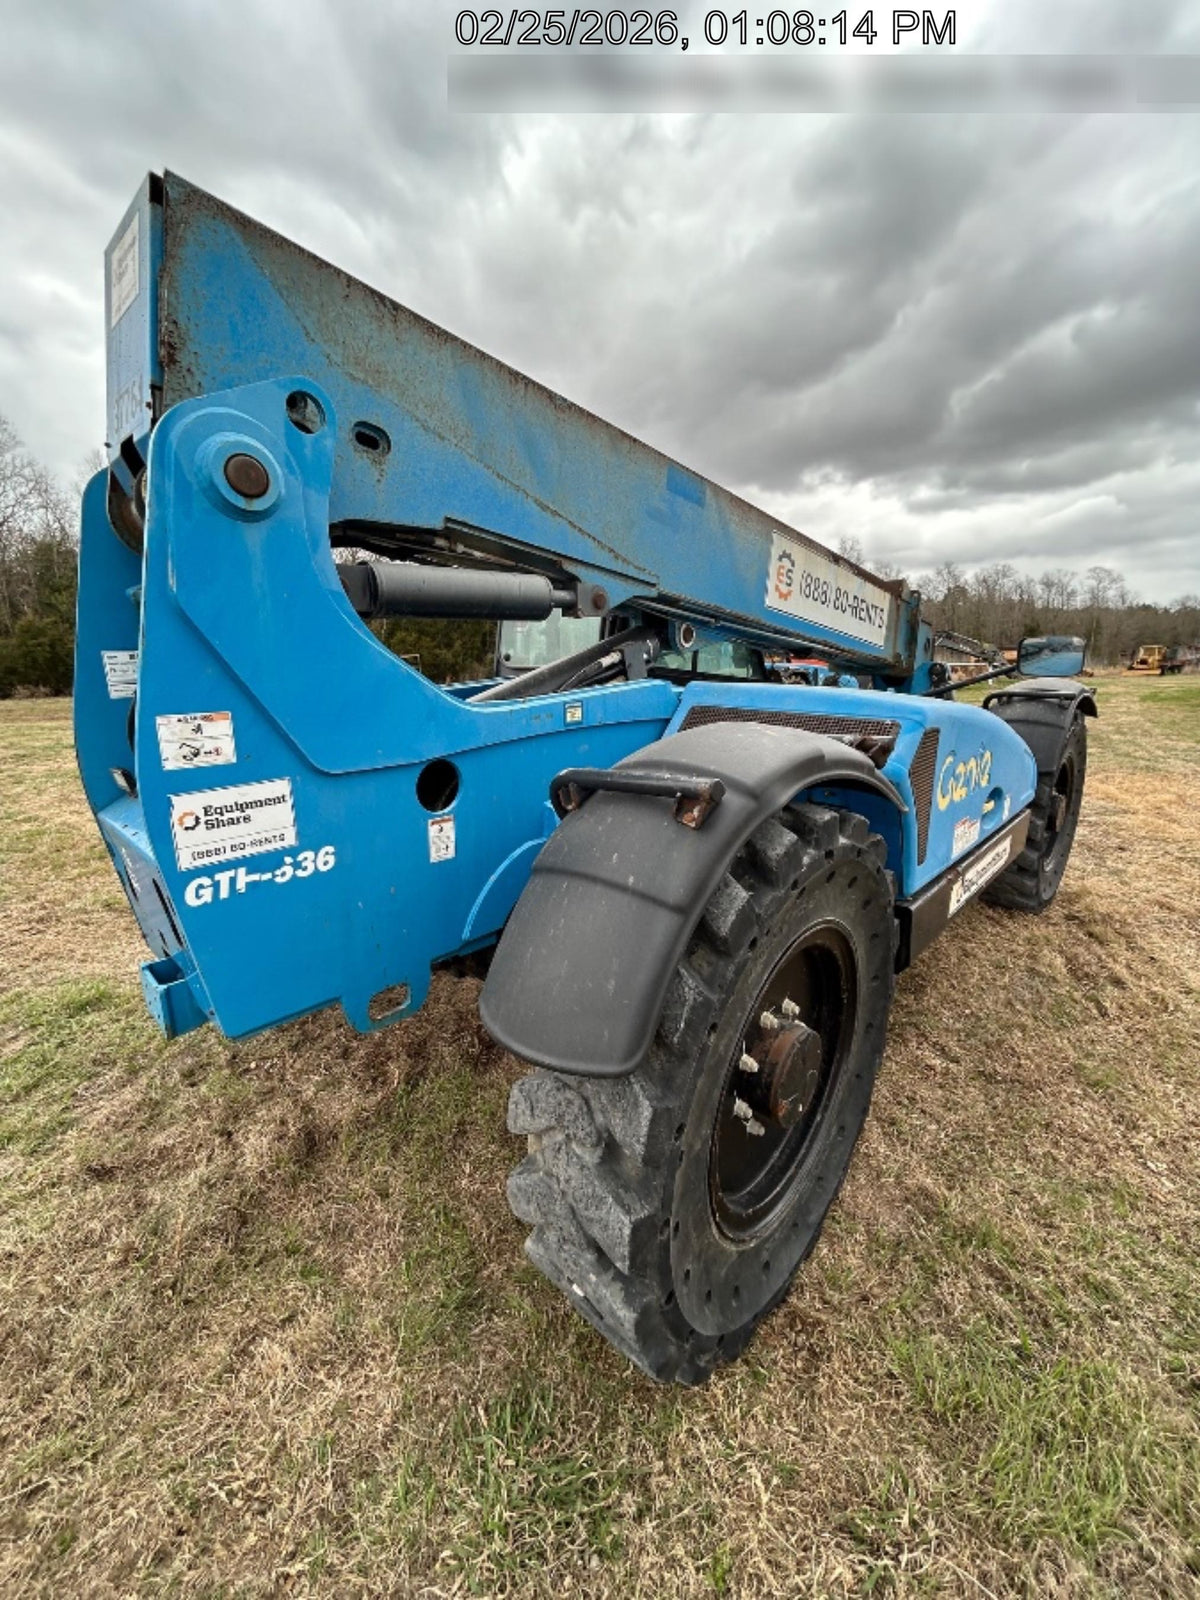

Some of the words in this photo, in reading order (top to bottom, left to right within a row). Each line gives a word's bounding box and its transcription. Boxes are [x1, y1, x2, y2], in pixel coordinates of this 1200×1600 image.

[799, 570, 832, 608] (888)
[834, 587, 885, 629] 80-RENTS
[202, 794, 288, 818] Equipment
[204, 814, 252, 831] Share
